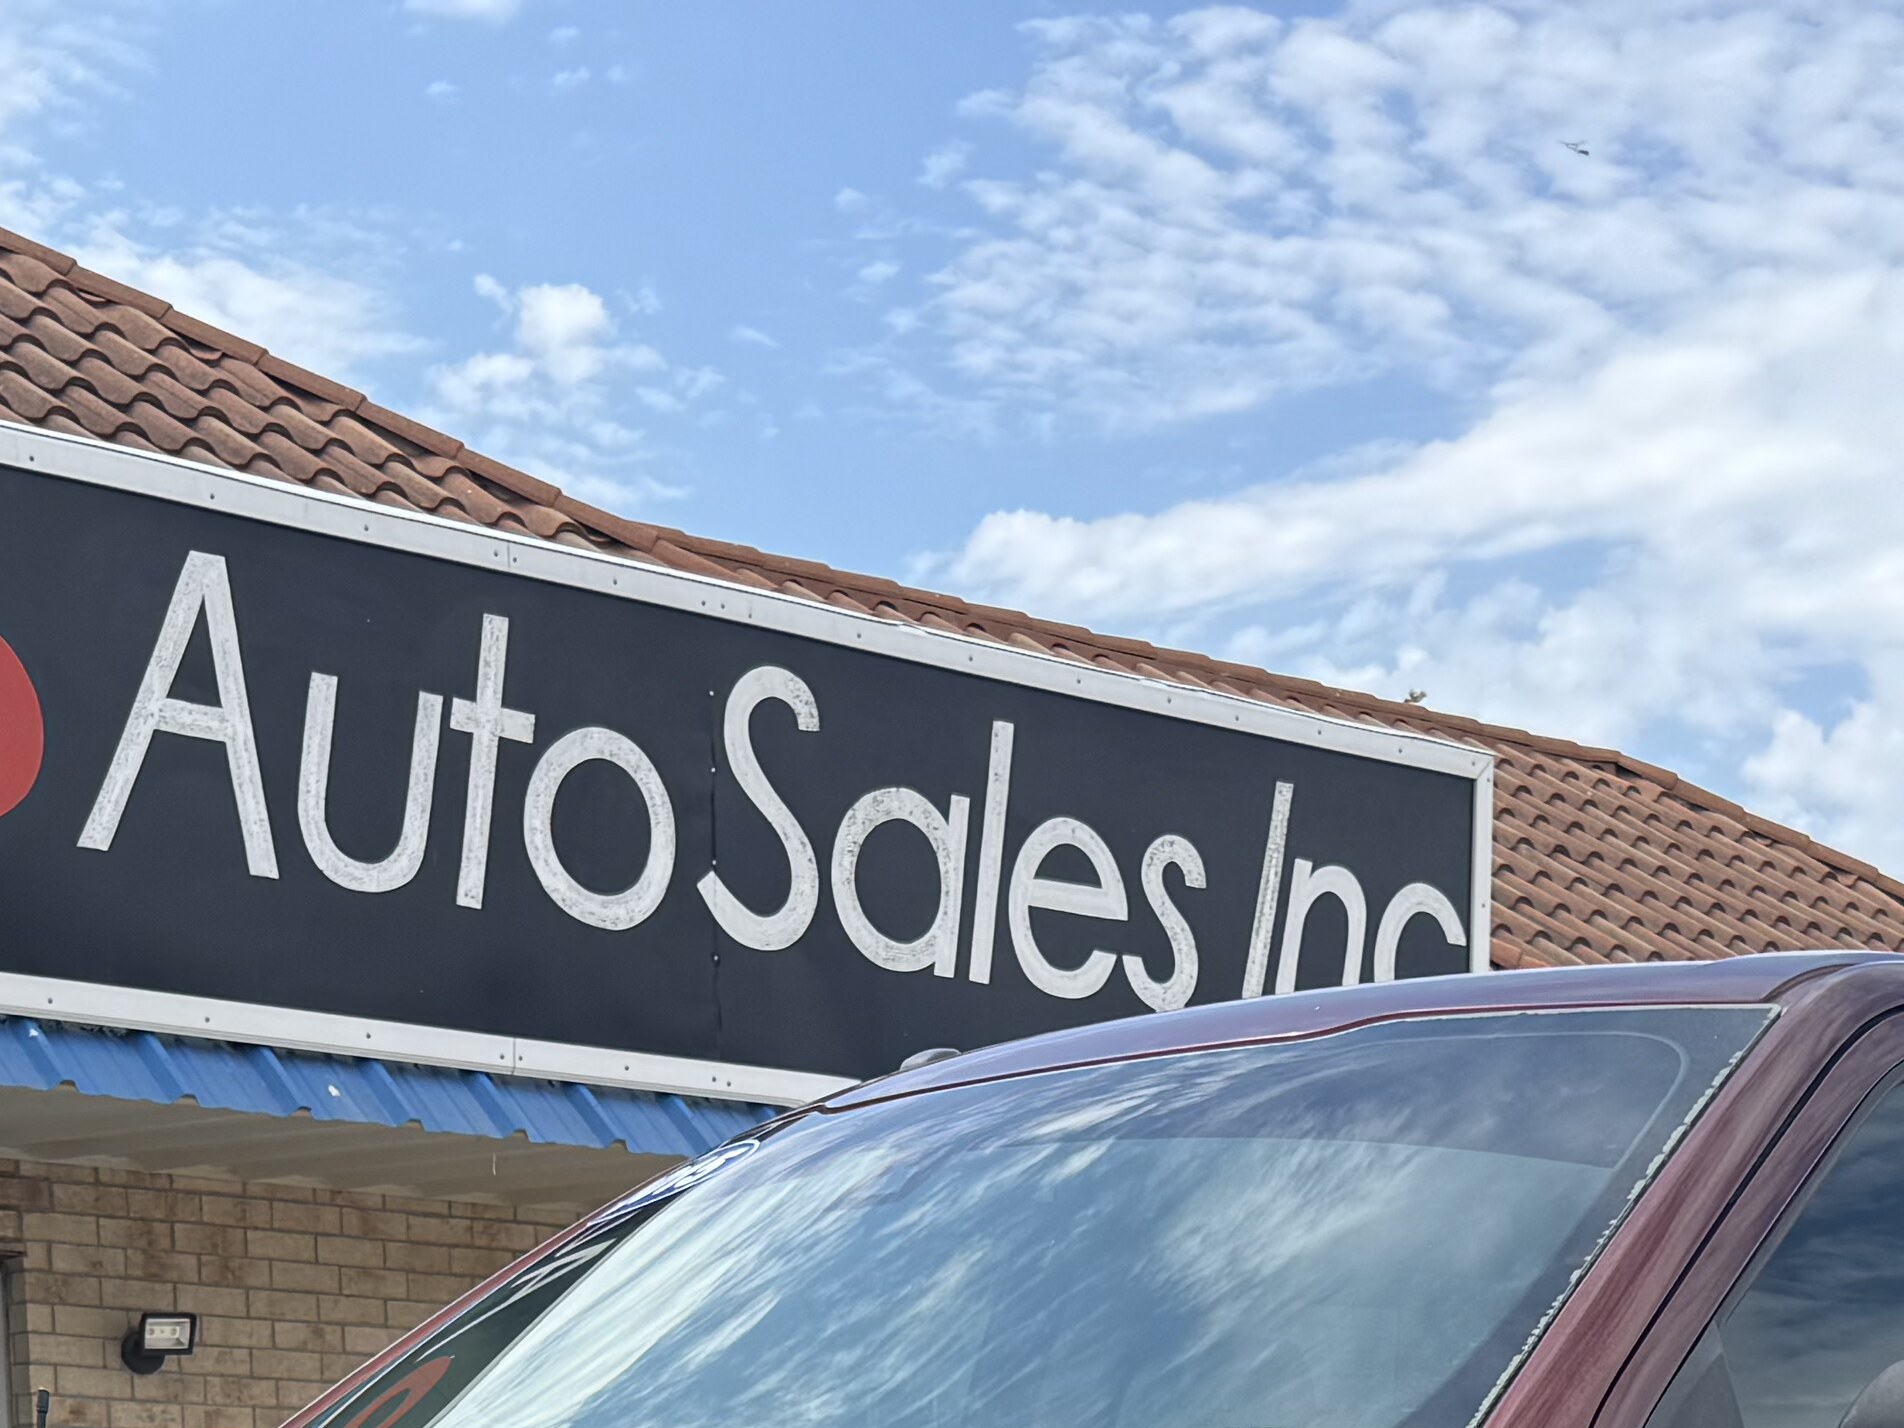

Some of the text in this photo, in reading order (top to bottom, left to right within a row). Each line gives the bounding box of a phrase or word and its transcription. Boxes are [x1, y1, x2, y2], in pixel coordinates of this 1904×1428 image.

[76, 550, 676, 931] Auto
[696, 665, 1207, 1011] Sales
[1242, 781, 1467, 999] Inc
